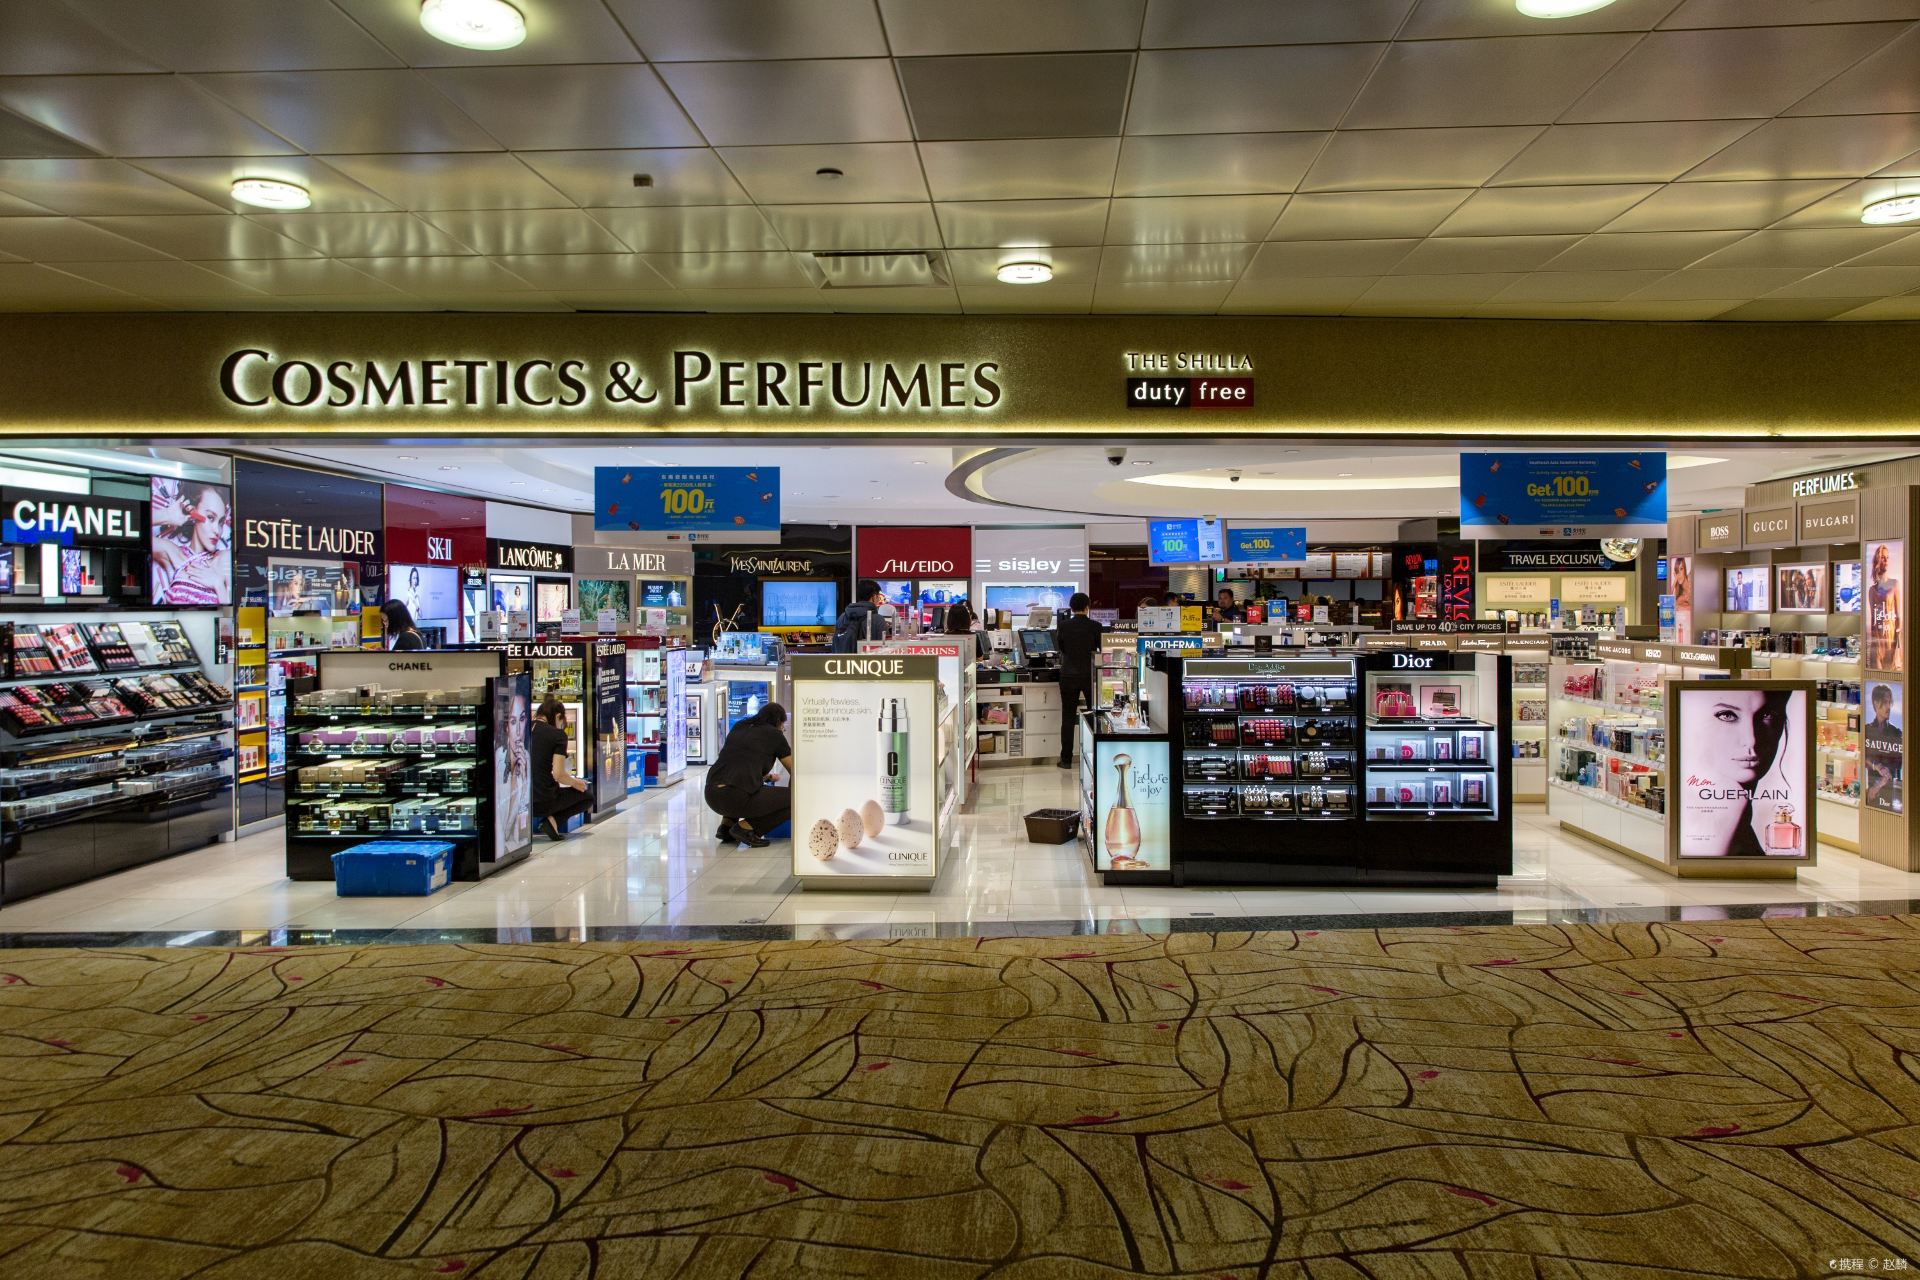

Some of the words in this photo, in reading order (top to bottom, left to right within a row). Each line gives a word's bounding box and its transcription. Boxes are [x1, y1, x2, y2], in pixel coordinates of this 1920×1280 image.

[1127, 352, 1169, 369] THE
[1177, 351, 1254, 369] SHILLA
[219, 348, 588, 408] COSMETICS
[604, 360, 658, 404] &
[673, 350, 1002, 409] PERFUMES
[1134, 381, 1185, 406] duty
[1199, 381, 1247, 400] free
[1792, 472, 1855, 498] PERFUMES
[13, 499, 140, 538] CHANEL
[1806, 514, 1855, 529] BVLGARI
[1710, 525, 1729, 537] BOSS
[1753, 519, 1789, 533] GUCCI
[308, 525, 375, 556] LAUDER
[427, 536, 453, 561] SK-II
[500, 546, 553, 568] LANCÔME
[607, 551, 631, 570] LA
[632, 553, 667, 572] MER
[1509, 554, 1548, 565] TRAVEL
[1549, 554, 1605, 564] EXCLUSIVE
[876, 559, 954, 573] SHISEIDO
[998, 557, 1061, 574] sisley
[1477, 623, 1501, 631] PRICES
[524, 645, 573, 656] LAUDER
[1144, 640, 1195, 650] BIOTHERM
[1612, 646, 1631, 655] JACOBS
[1645, 648, 1662, 658] KENZO
[389, 662, 433, 671] CHANEL
[824, 659, 904, 677] CLINIQUE
[1392, 653, 1433, 669] Dior
[1865, 739, 1903, 753] SAUVAGE
[1687, 775, 1716, 787] Mon
[1698, 788, 1788, 800] GUERLAIN
[888, 852, 928, 862] CLINIQUE
